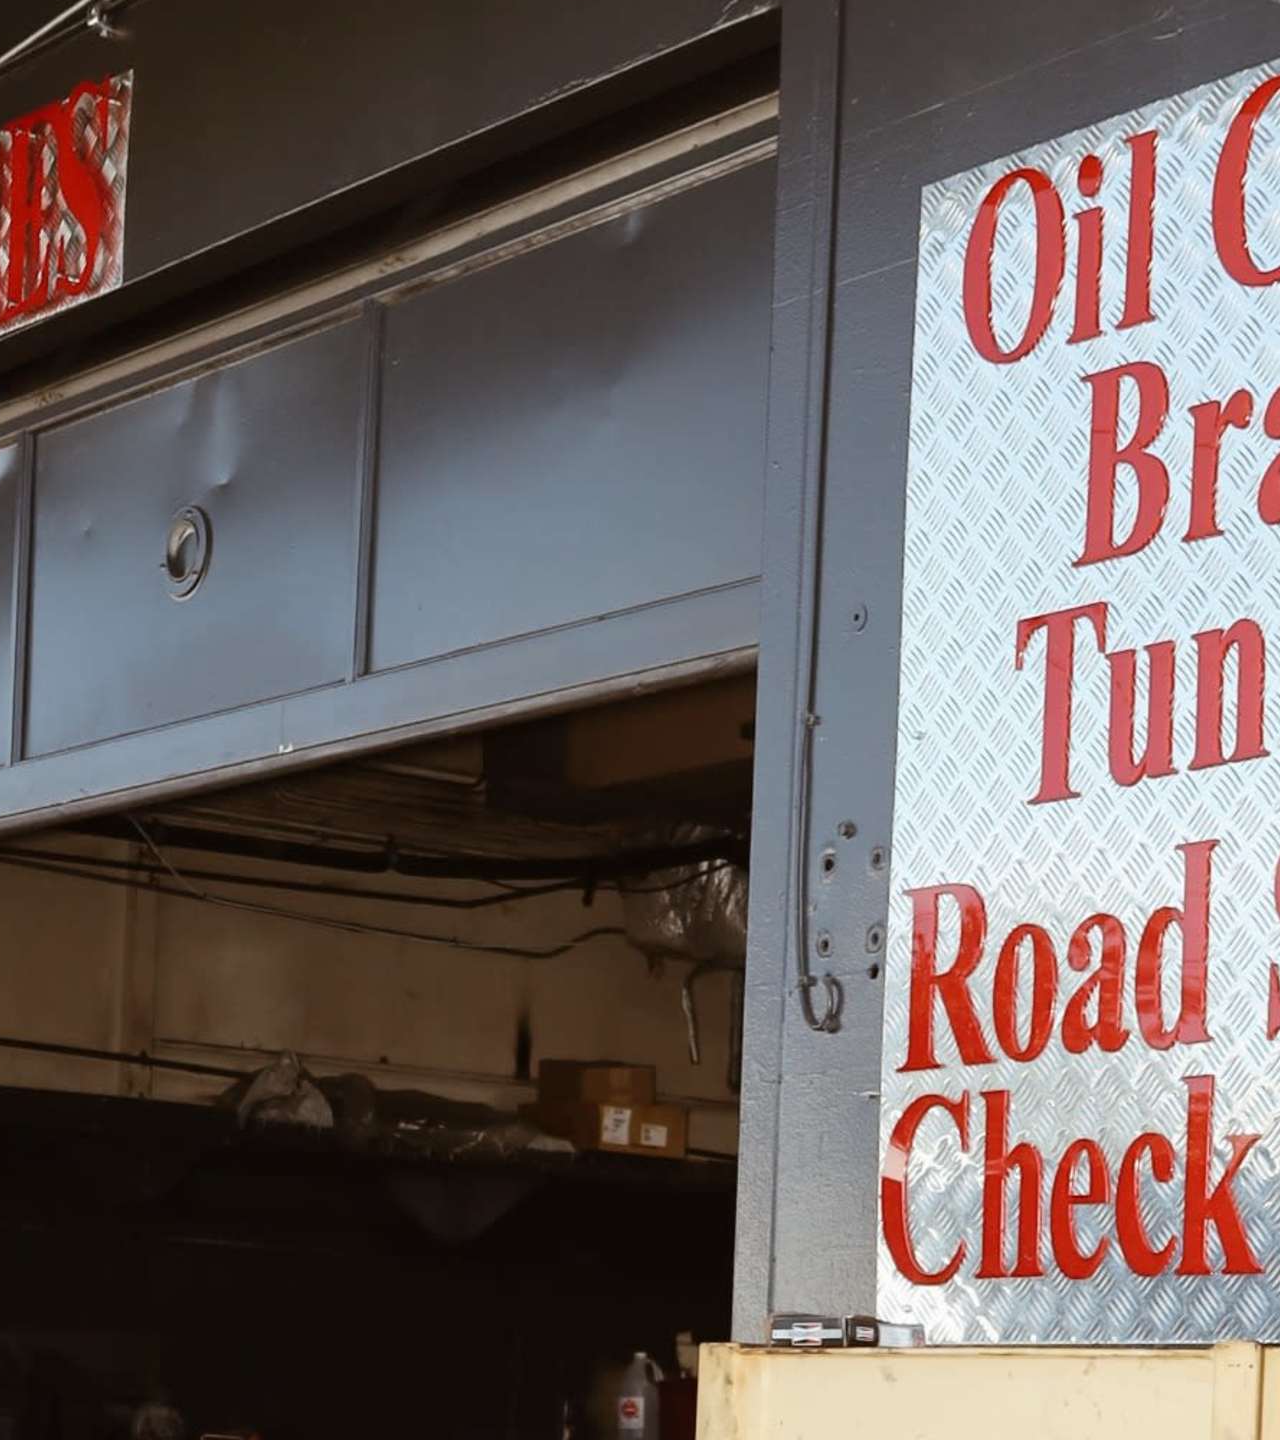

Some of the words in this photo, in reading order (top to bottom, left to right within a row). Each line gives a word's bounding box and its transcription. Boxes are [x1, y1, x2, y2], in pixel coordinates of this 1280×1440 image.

[963, 132, 1156, 364] Oil
[896, 840, 1214, 1073] Road
[880, 1075, 1264, 1287] Check
